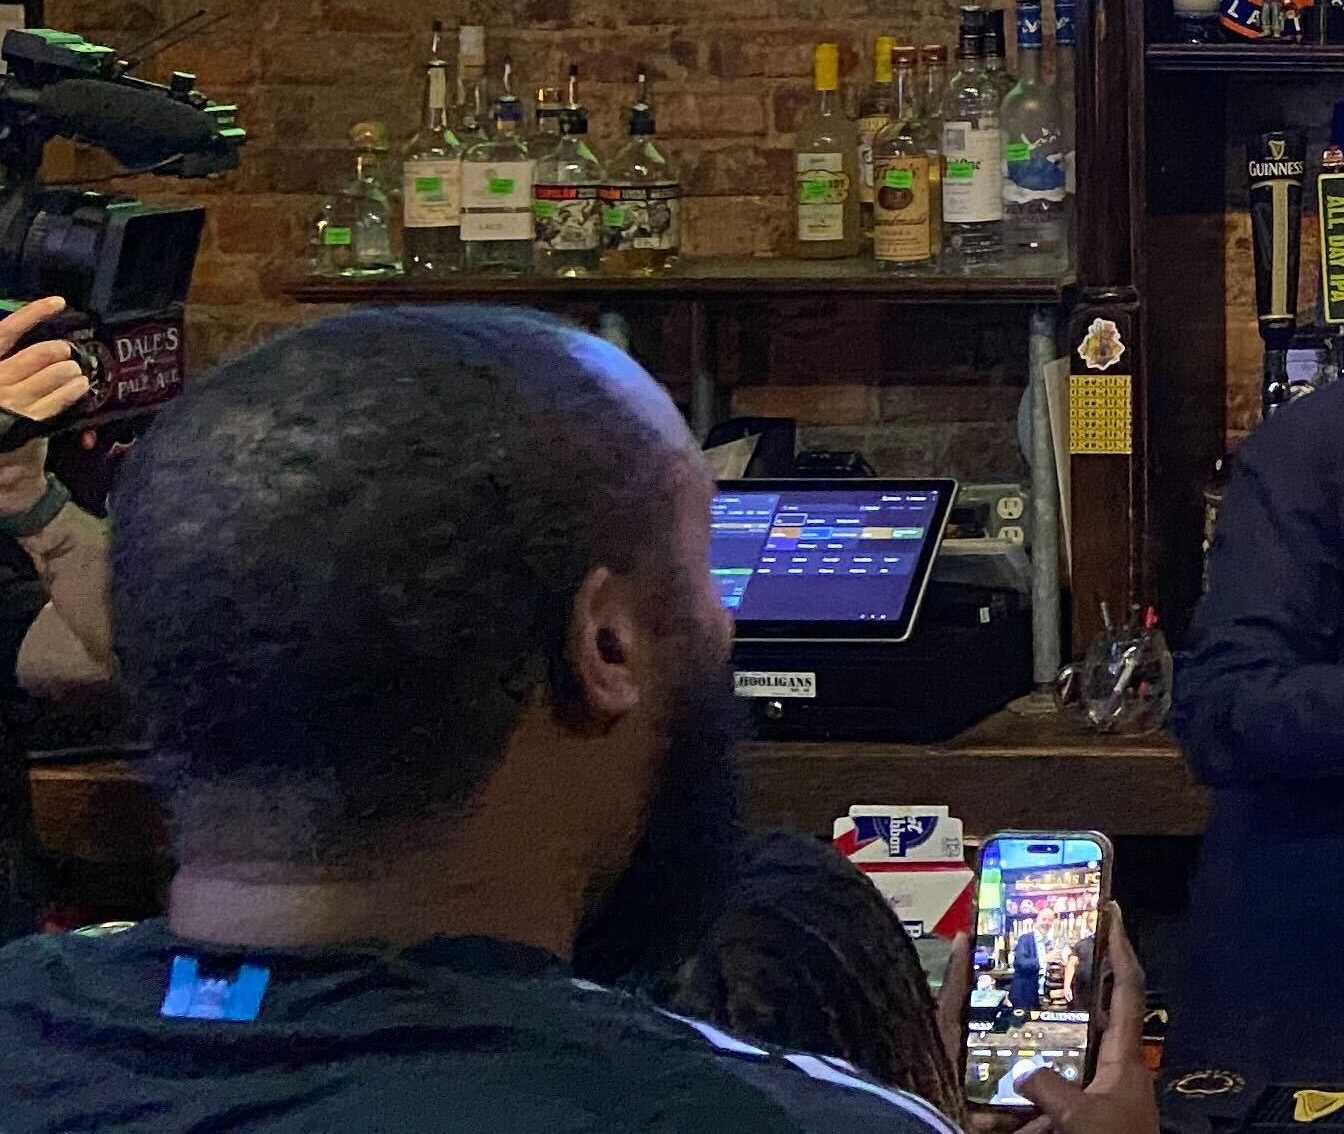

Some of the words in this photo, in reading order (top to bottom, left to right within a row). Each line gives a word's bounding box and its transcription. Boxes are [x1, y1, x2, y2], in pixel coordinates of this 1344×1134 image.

[1248, 160, 1304, 177] GUINNESS
[116, 327, 179, 363] DALE'S
[740, 676, 812, 687] HOOLIGANS
